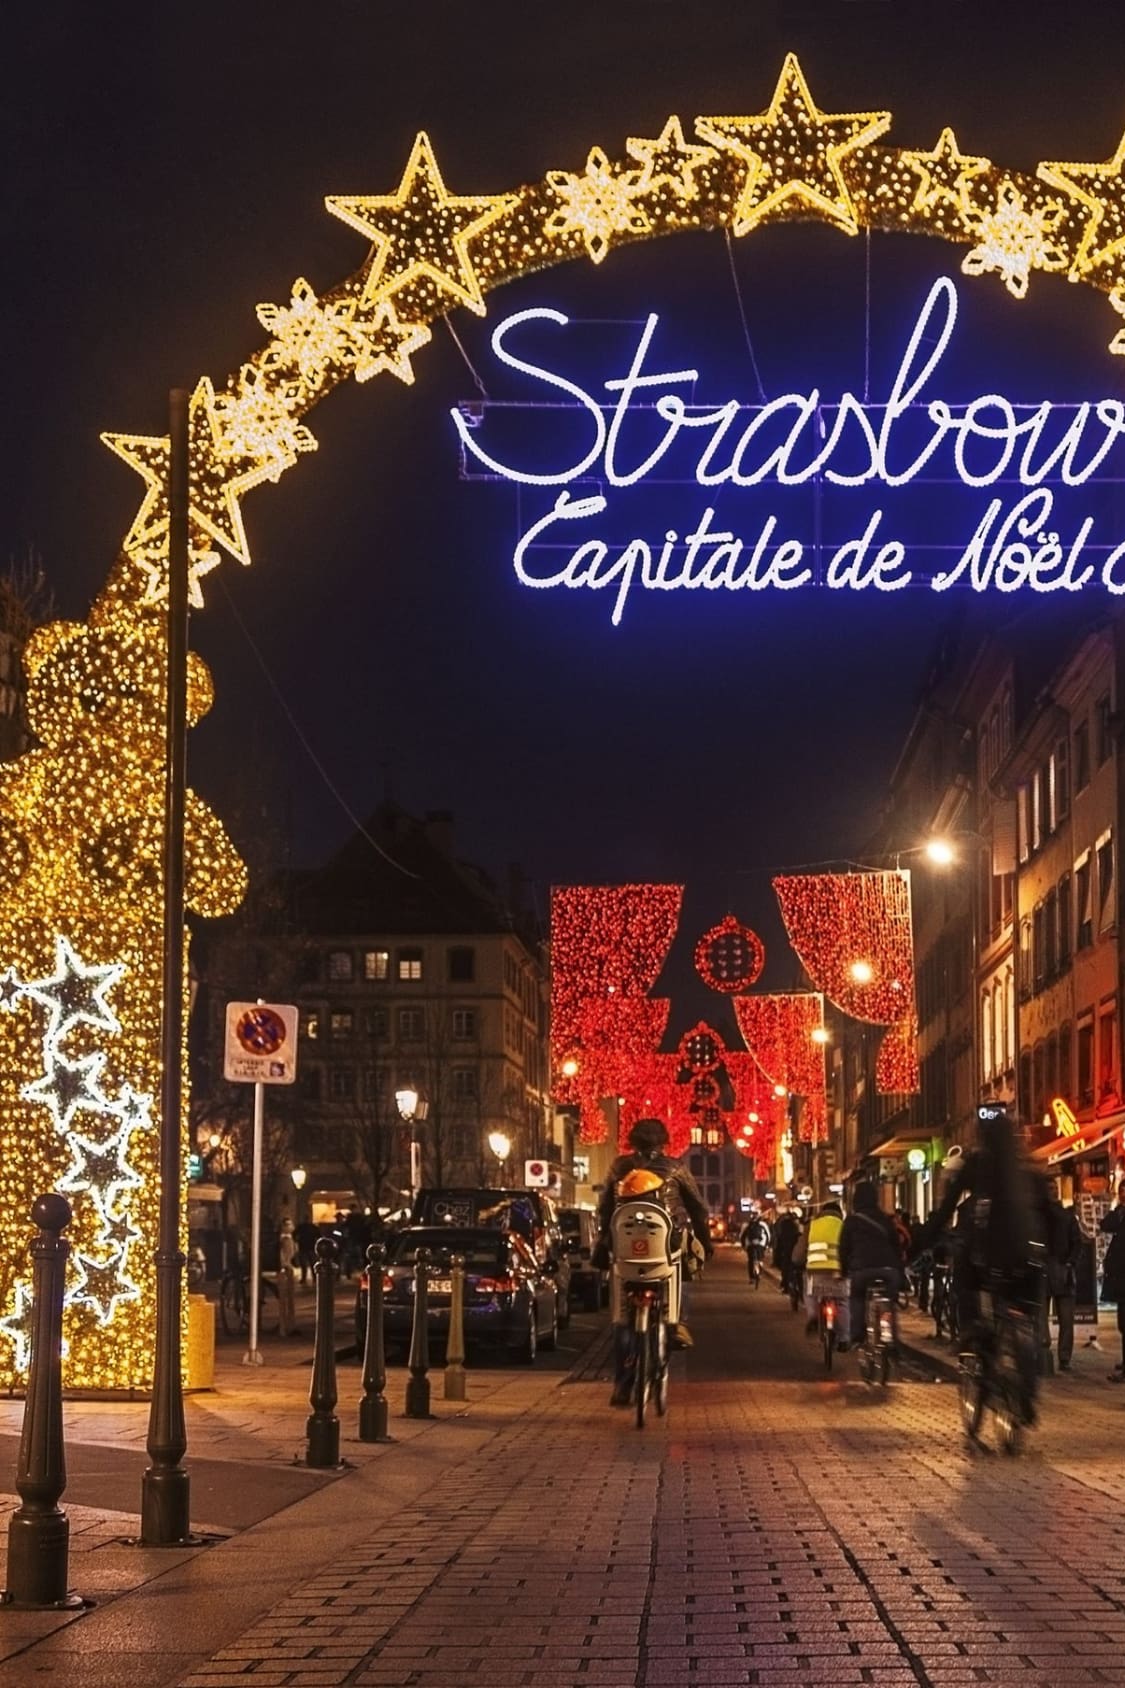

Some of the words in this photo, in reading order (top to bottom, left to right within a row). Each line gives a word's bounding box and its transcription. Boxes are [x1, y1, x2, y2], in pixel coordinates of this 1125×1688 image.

[513, 490, 813, 625] Capitale
[827, 510, 912, 592] de
[931, 487, 1097, 592] Noël
